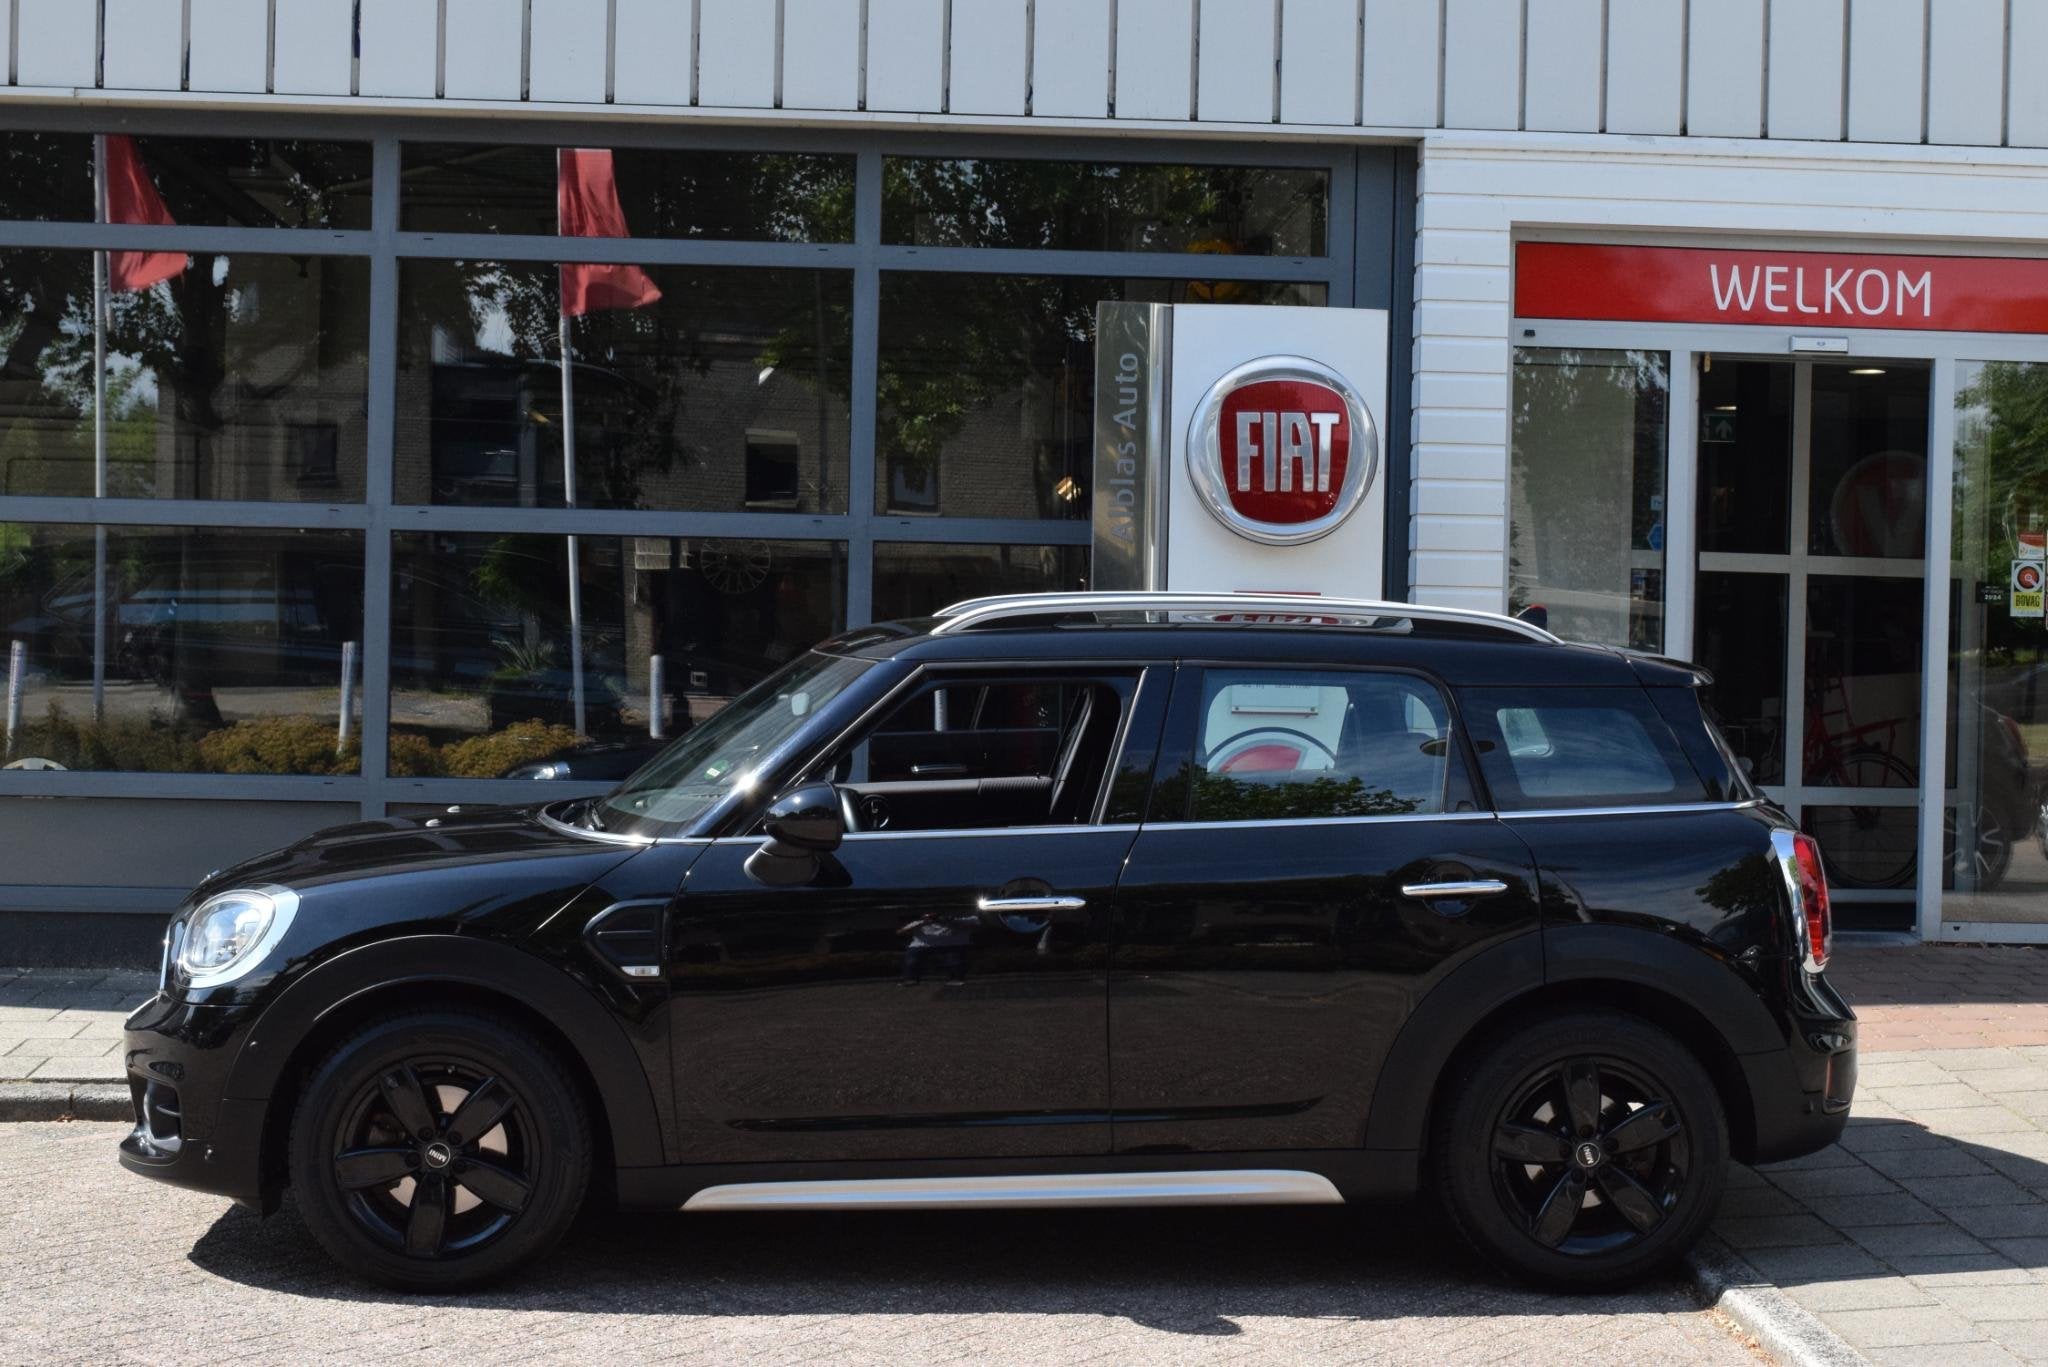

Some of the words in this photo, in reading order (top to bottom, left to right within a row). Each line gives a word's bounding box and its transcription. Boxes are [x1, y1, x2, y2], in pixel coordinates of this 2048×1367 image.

[1710, 264, 1932, 317] WELKOM
[1113, 353, 1139, 430] Auto
[1236, 411, 1341, 493] FIAT
[1107, 441, 1137, 546] Alblas
[2015, 595, 2040, 608] BOVAG
